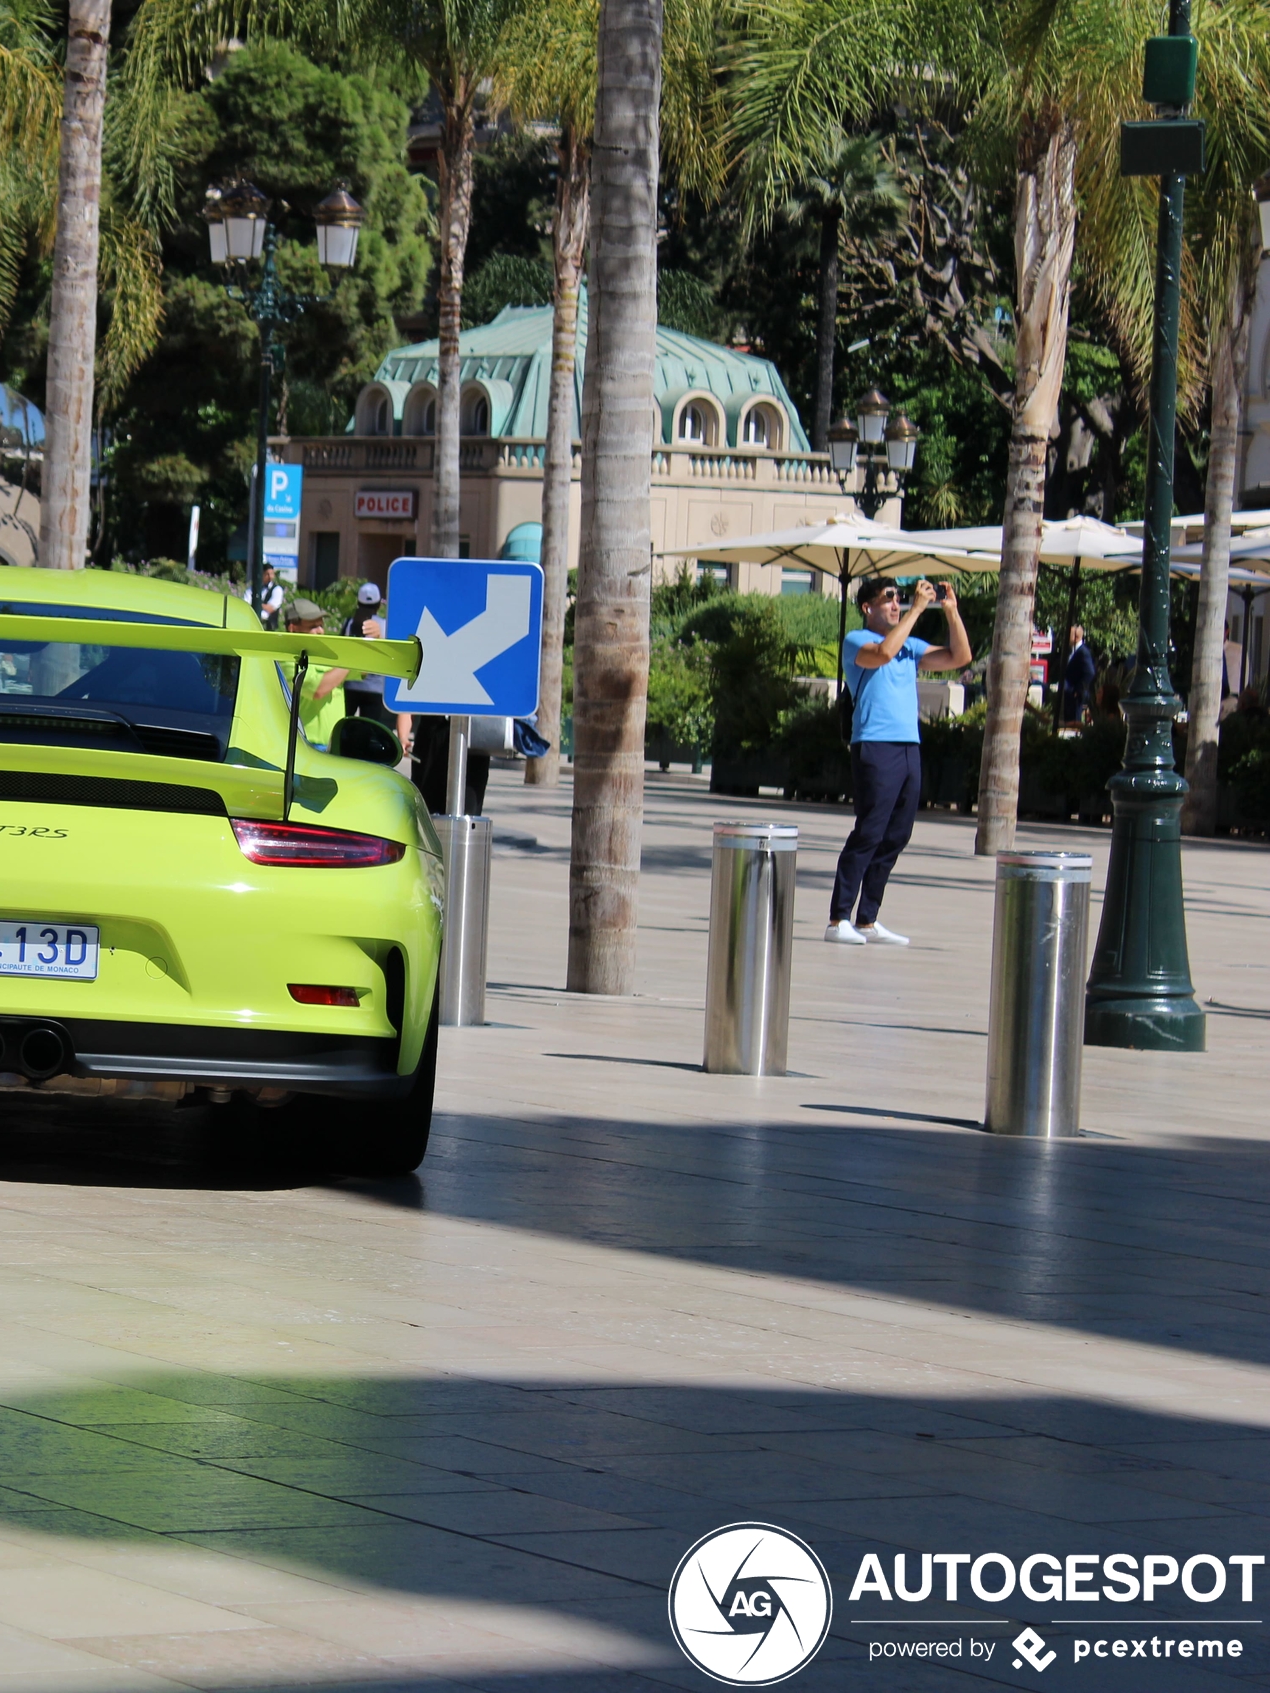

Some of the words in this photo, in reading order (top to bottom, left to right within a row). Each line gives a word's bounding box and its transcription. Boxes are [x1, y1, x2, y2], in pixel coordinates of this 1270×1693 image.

[271, 470, 289, 500] P
[357, 496, 410, 512] POLICE
[35, 964, 44, 972] DE
[47, 965, 79, 974] MONACO
